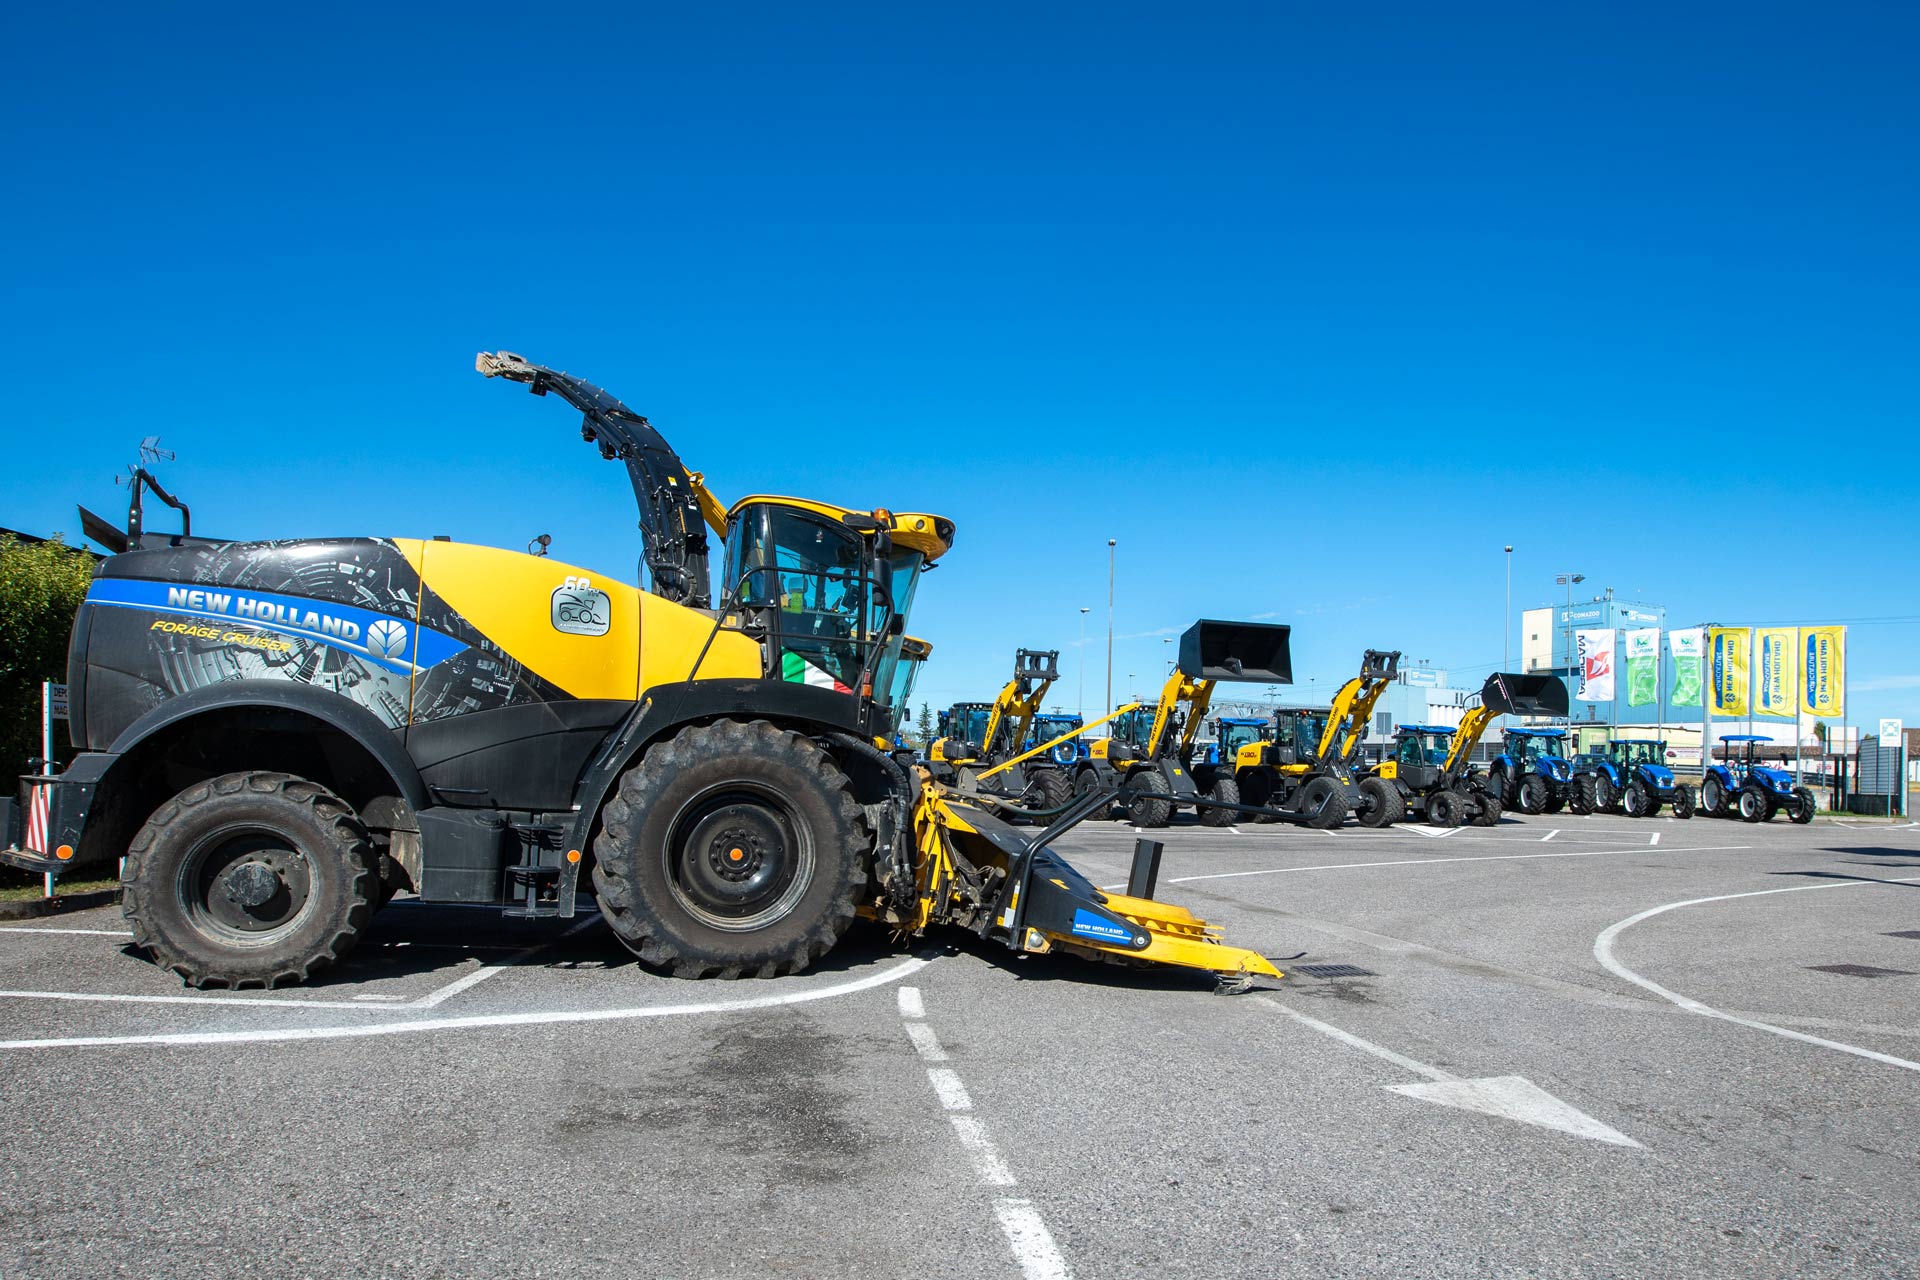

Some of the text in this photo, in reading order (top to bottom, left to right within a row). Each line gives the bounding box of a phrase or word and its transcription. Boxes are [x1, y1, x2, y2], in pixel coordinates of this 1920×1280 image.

[168, 587, 360, 641] NEW HOLLAND
[151, 620, 293, 653] FORAGE CRUISER
[1092, 925, 1124, 936] HOLLAND
